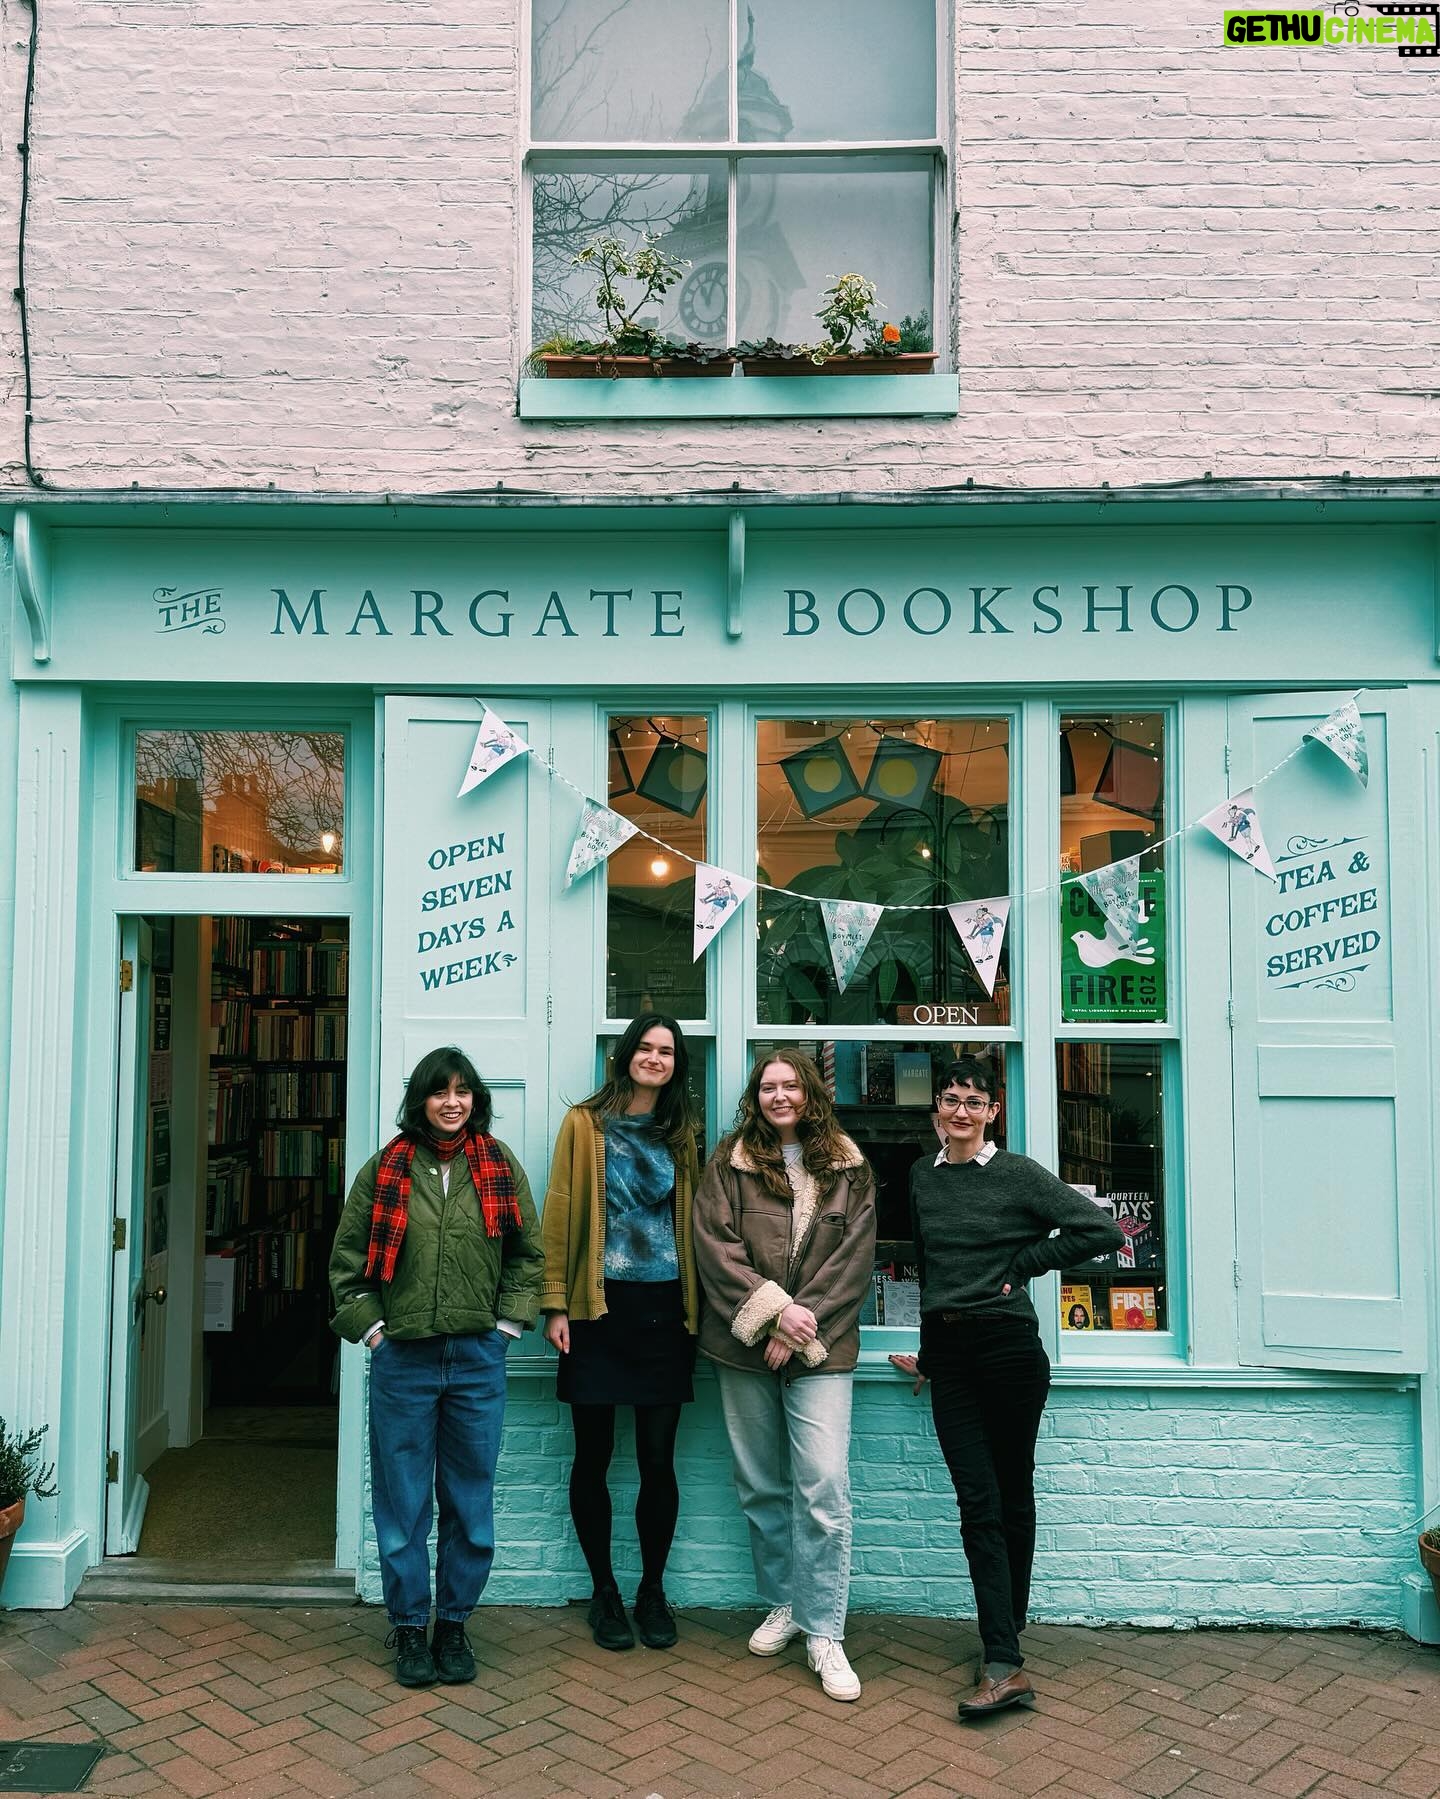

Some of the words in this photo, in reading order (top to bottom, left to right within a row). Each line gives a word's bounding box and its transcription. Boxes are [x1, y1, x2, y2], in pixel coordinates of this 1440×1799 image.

[158, 592, 222, 627] THE
[270, 588, 686, 637] MARGATE
[782, 584, 1253, 636] BOOKSHOP
[427, 832, 505, 871] OPEN
[1275, 859, 1337, 895] TEA
[1348, 850, 1371, 874] &
[421, 869, 513, 913] SEVEN
[1069, 886, 1157, 918] CEE
[1265, 887, 1378, 937] COFFEE
[417, 917, 486, 953] DAYS
[496, 910, 516, 933] A
[419, 950, 502, 992] WEEK
[1266, 930, 1381, 978] SERVED
[1070, 975, 1135, 1006] FIRE
[1139, 975, 1157, 1006] NOW
[913, 1004, 980, 1025] OPEN
[1106, 1191, 1150, 1202] FOURTEEN
[1112, 1292, 1156, 1311] FIRE
